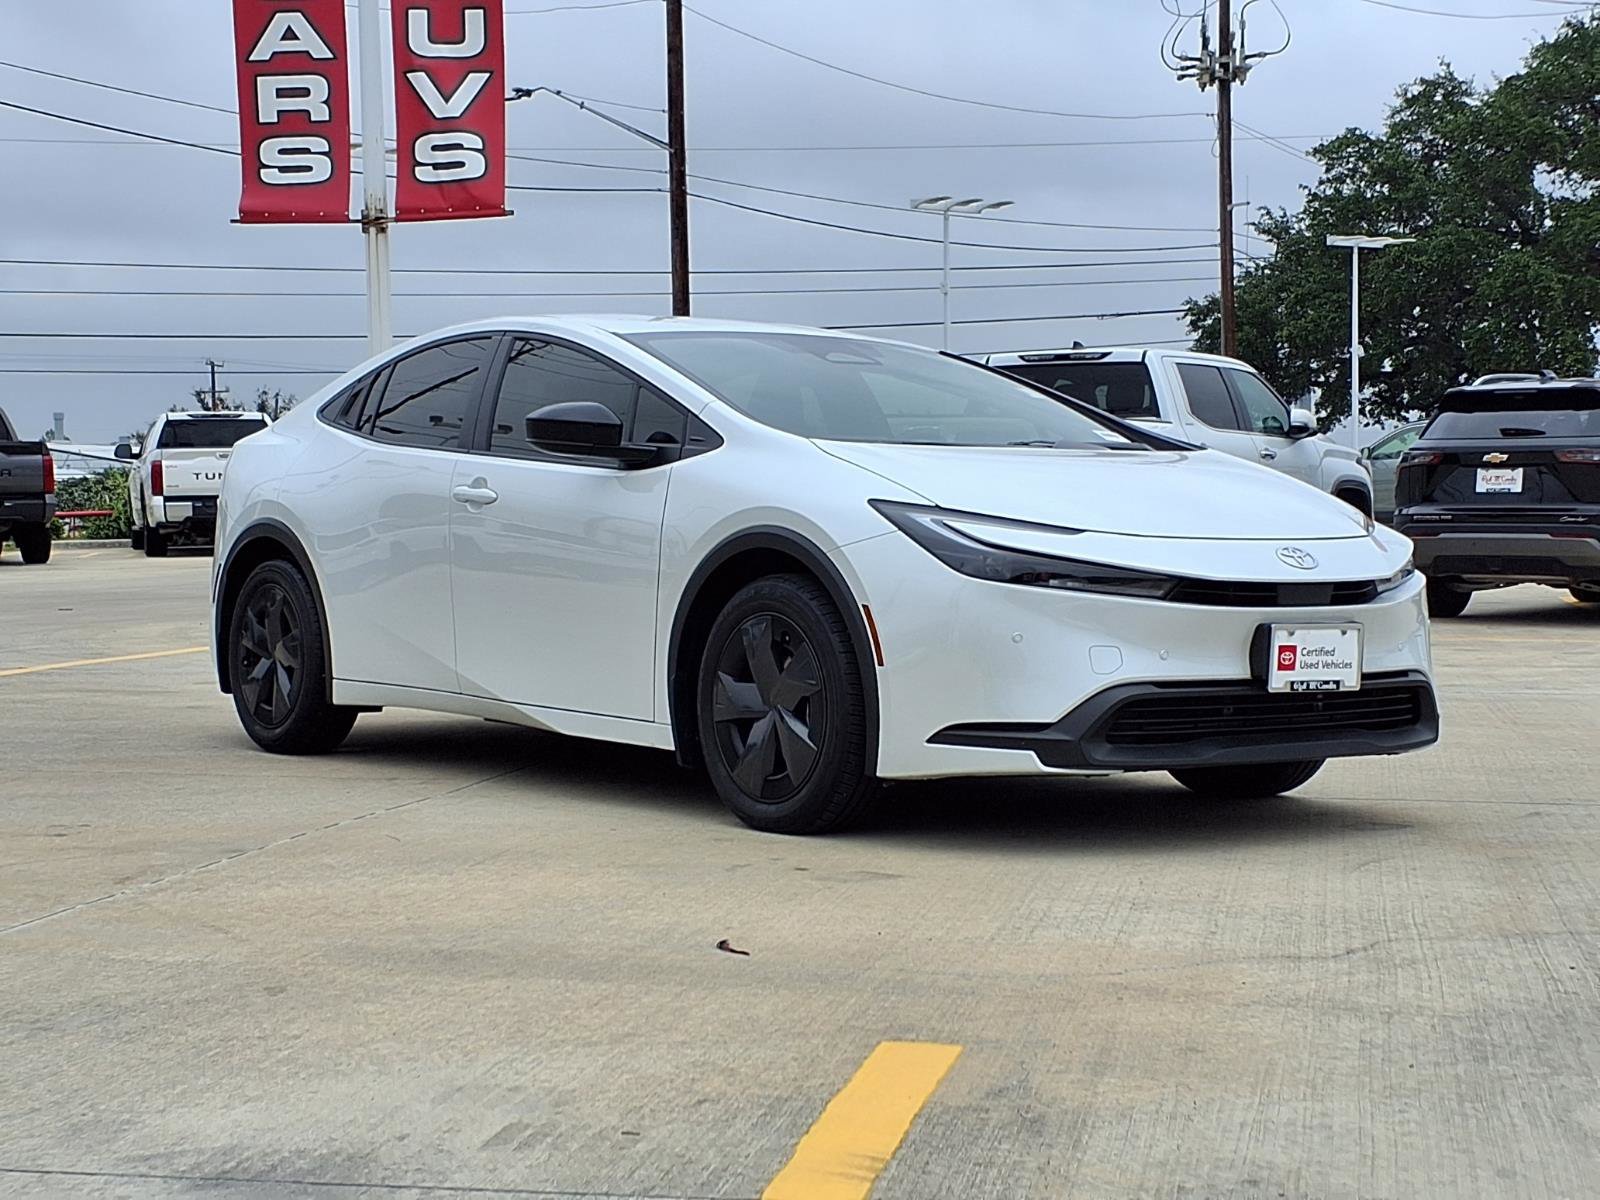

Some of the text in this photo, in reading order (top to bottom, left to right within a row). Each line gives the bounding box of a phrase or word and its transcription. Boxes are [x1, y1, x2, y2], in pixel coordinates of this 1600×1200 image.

[247, 10, 337, 185] ARS
[404, 8, 493, 183] UVS
[1299, 659, 1353, 669] Used Vehicles
[1300, 646, 1336, 657] Certified
